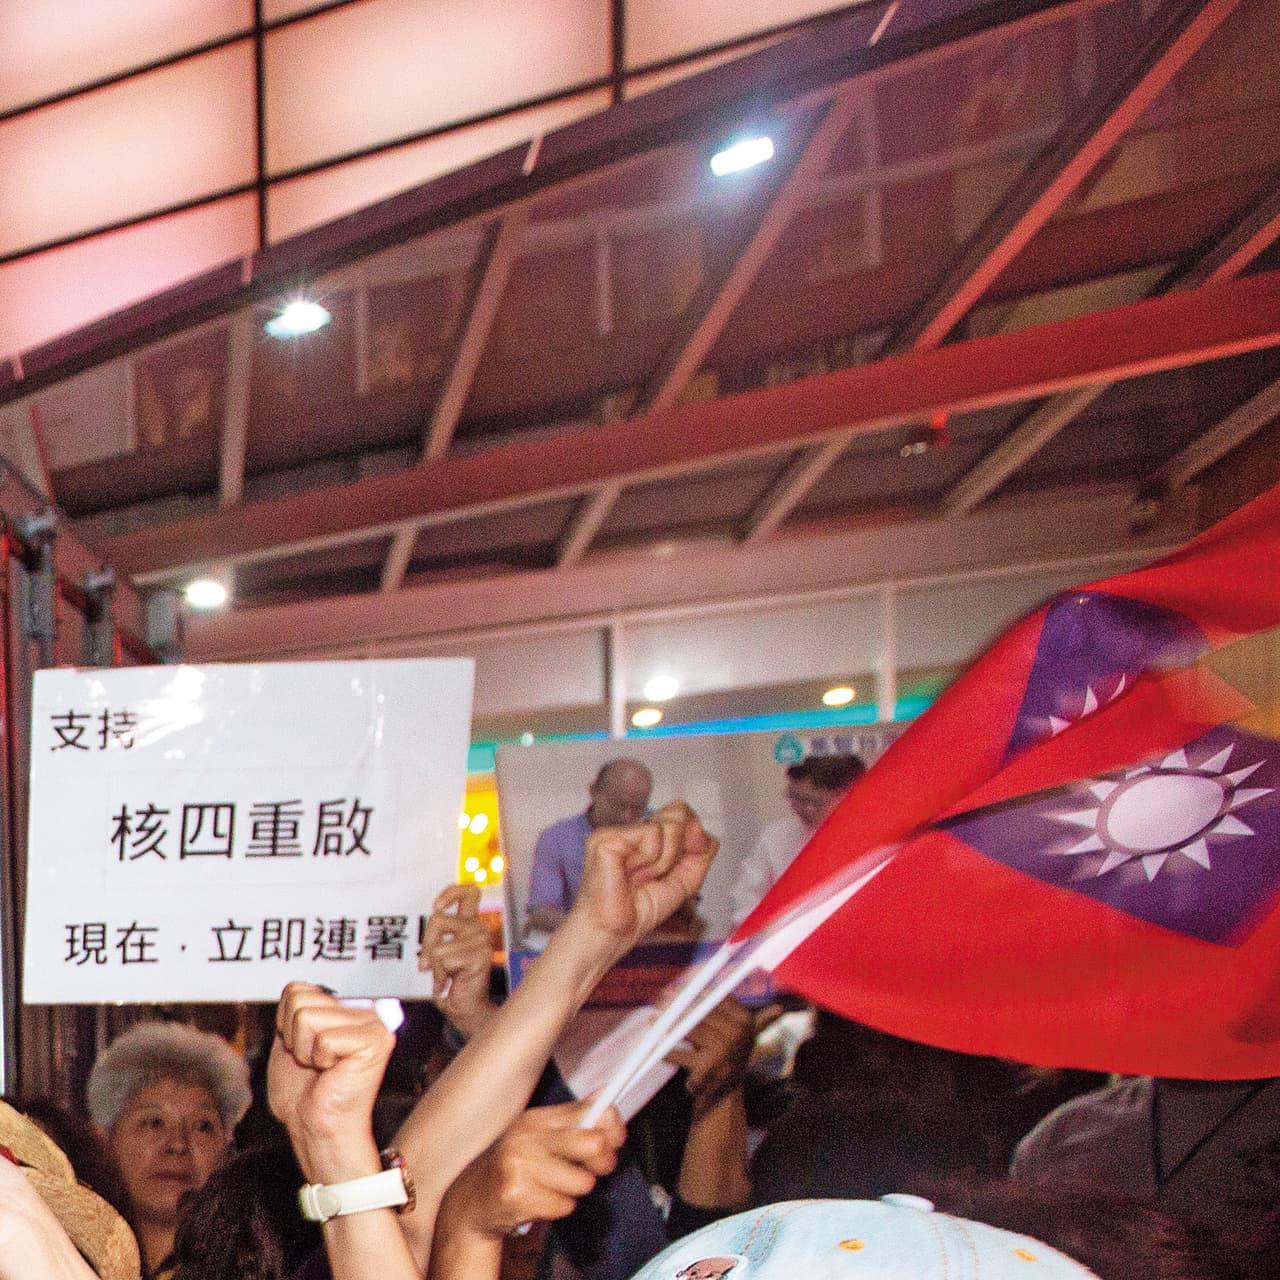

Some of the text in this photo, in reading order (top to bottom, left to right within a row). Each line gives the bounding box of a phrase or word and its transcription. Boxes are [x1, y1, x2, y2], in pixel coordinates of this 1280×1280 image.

[49, 707, 139, 752] 支持
[109, 797, 376, 863] 核四重啟
